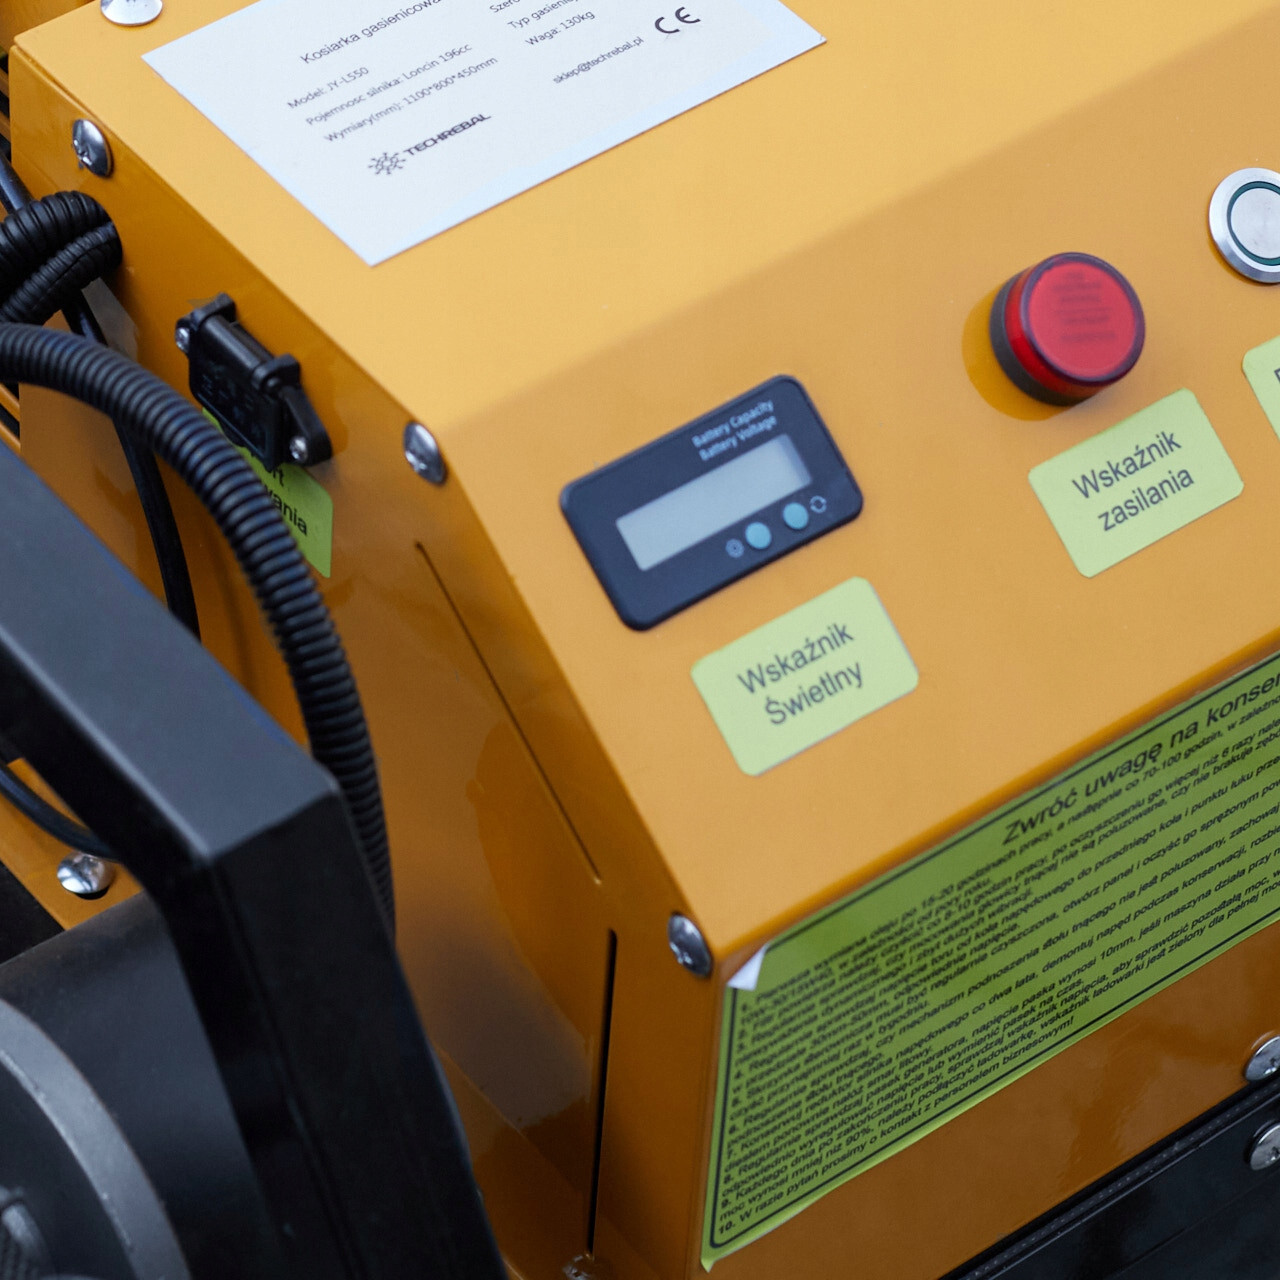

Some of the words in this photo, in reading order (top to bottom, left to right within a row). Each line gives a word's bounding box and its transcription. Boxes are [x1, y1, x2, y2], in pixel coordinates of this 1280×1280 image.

[300, 33, 360, 63] Kosiarka
[507, 16, 530, 28] Typ
[525, 28, 558, 45] Waga:
[559, 11, 595, 29] 130kg
[654, 6, 700, 34] CE
[404, 114, 490, 155] TECHREBAL
[1071, 431, 1181, 498] Wskaźnik
[1097, 469, 1194, 531] zasilania
[737, 623, 853, 693] Wskaźnik
[764, 662, 862, 724] Świetlny
[1002, 787, 1077, 845] Zwróć
[1084, 742, 1162, 797] uwagę
[1169, 721, 1198, 748] na
[903, 1036, 967, 1079] generatora,
[971, 1004, 1019, 1037] napięcie
[1021, 982, 1055, 1009] paska
[1058, 957, 1096, 985] wynosi
[1100, 935, 1135, 959] 10mm,
[1138, 917, 1161, 940] jeśli
[1163, 888, 1211, 922] maszyna
[1214, 868, 1245, 892] działa
[1247, 852, 1271, 873] przy
[876, 1072, 924, 1105] napięcie
[927, 1060, 945, 1075] lub
[947, 1026, 999, 1062] wymienić
[1002, 1005, 1036, 1032] pasek
[1038, 995, 1054, 1013] na
[1055, 978, 1083, 998] czas.
[718, 1220, 735, 1234] 10.
[739, 1208, 752, 1221] W
[754, 1191, 783, 1212] razie
[786, 1169, 818, 1196] pytań
[820, 1141, 867, 1175] prosimy
[869, 1135, 877, 1144] o
[879, 1107, 921, 1137] kontakt
[923, 1102, 931, 1112] z
[933, 1062, 999, 1107] personelem
[1002, 1015, 1074, 1065] biznesowym!
